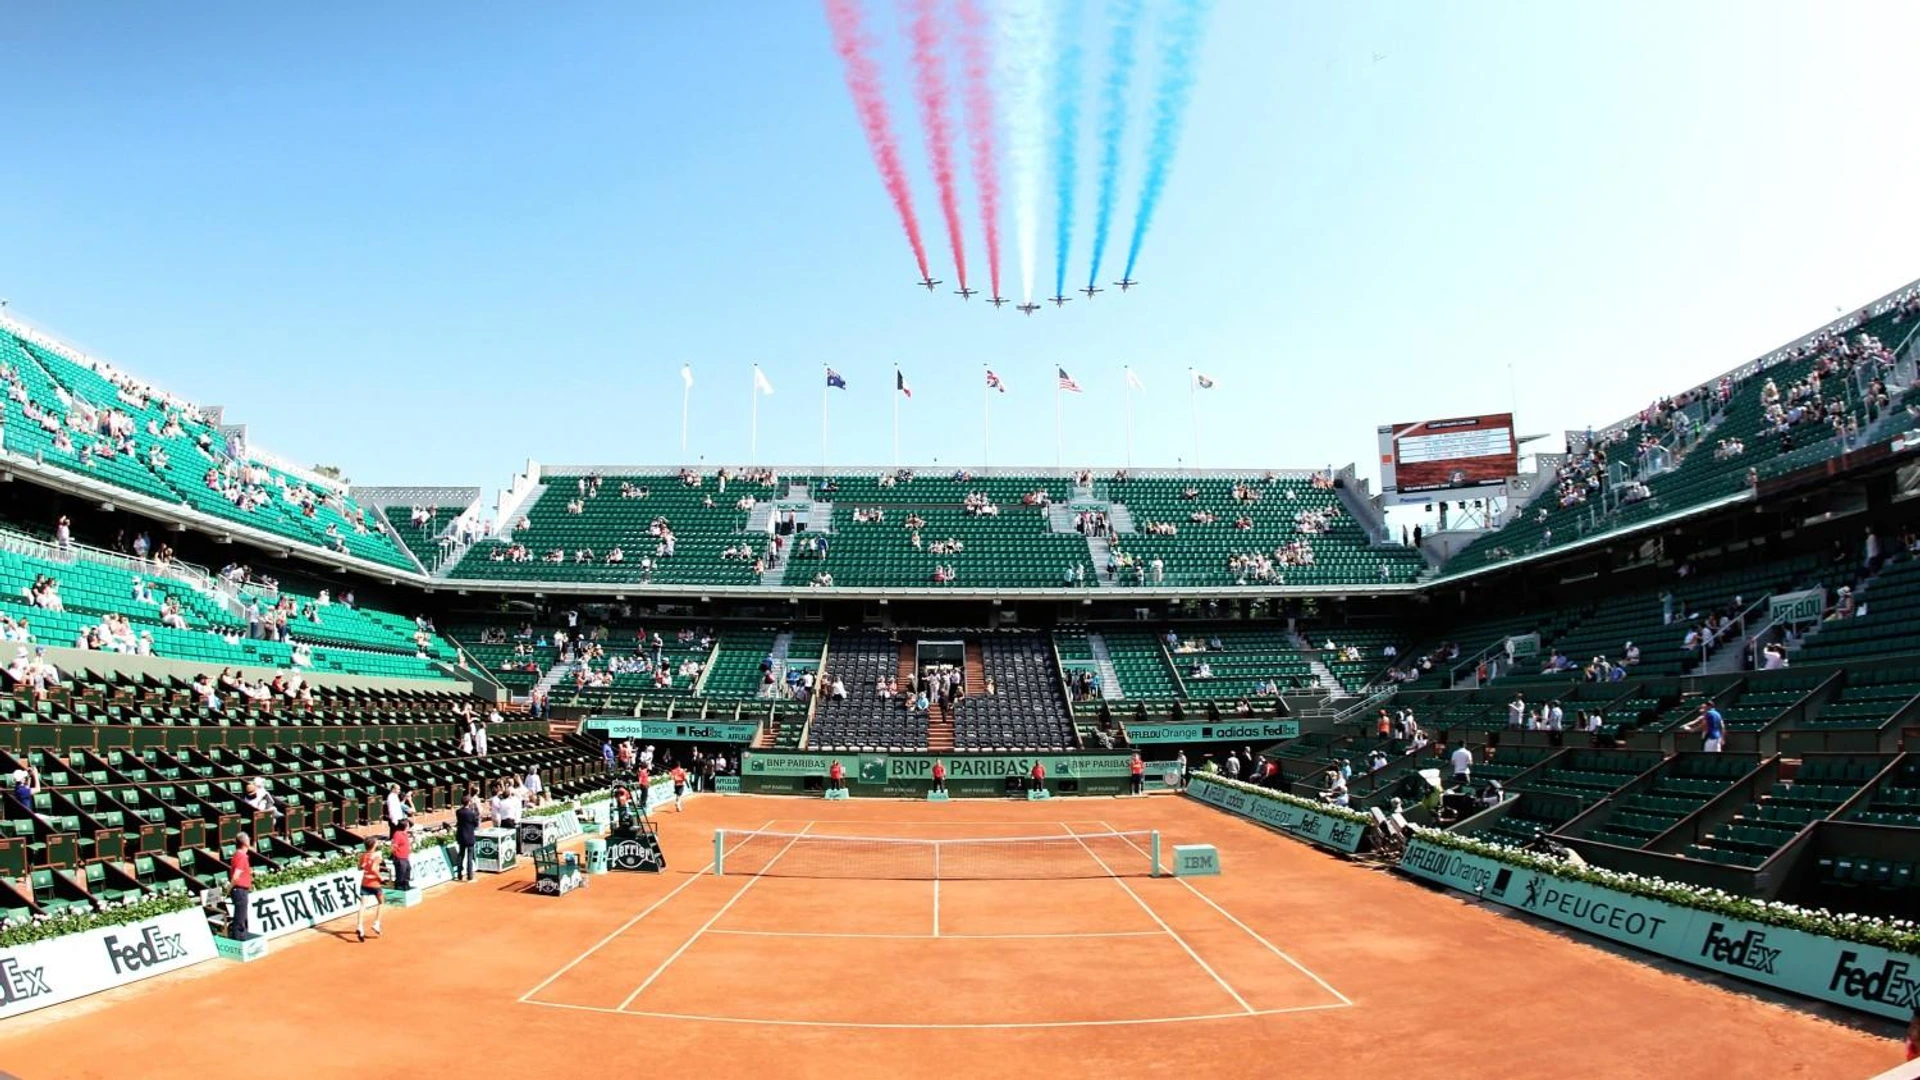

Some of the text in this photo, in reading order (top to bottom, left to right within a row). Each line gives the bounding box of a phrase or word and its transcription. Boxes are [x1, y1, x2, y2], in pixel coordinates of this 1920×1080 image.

[613, 724, 640, 733] adidas
[1161, 727, 1197, 738] Orange
[1216, 725, 1259, 738] adidas
[788, 759, 825, 767] PARIBAS
[892, 759, 1029, 775] BNP PARIBAS
[1094, 759, 1130, 768] PARIBAS
[1184, 855, 1213, 869] IBM
[1403, 845, 1492, 888] AFFLELOU Orange
[252, 876, 362, 932] 东风标致
[1543, 889, 1666, 939] PEUGEOT
[104, 925, 188, 975] FedEx
[216, 943, 244, 954] COSTE
[1702, 922, 1782, 974] FedEx
[1829, 951, 1920, 1010] FedEx
